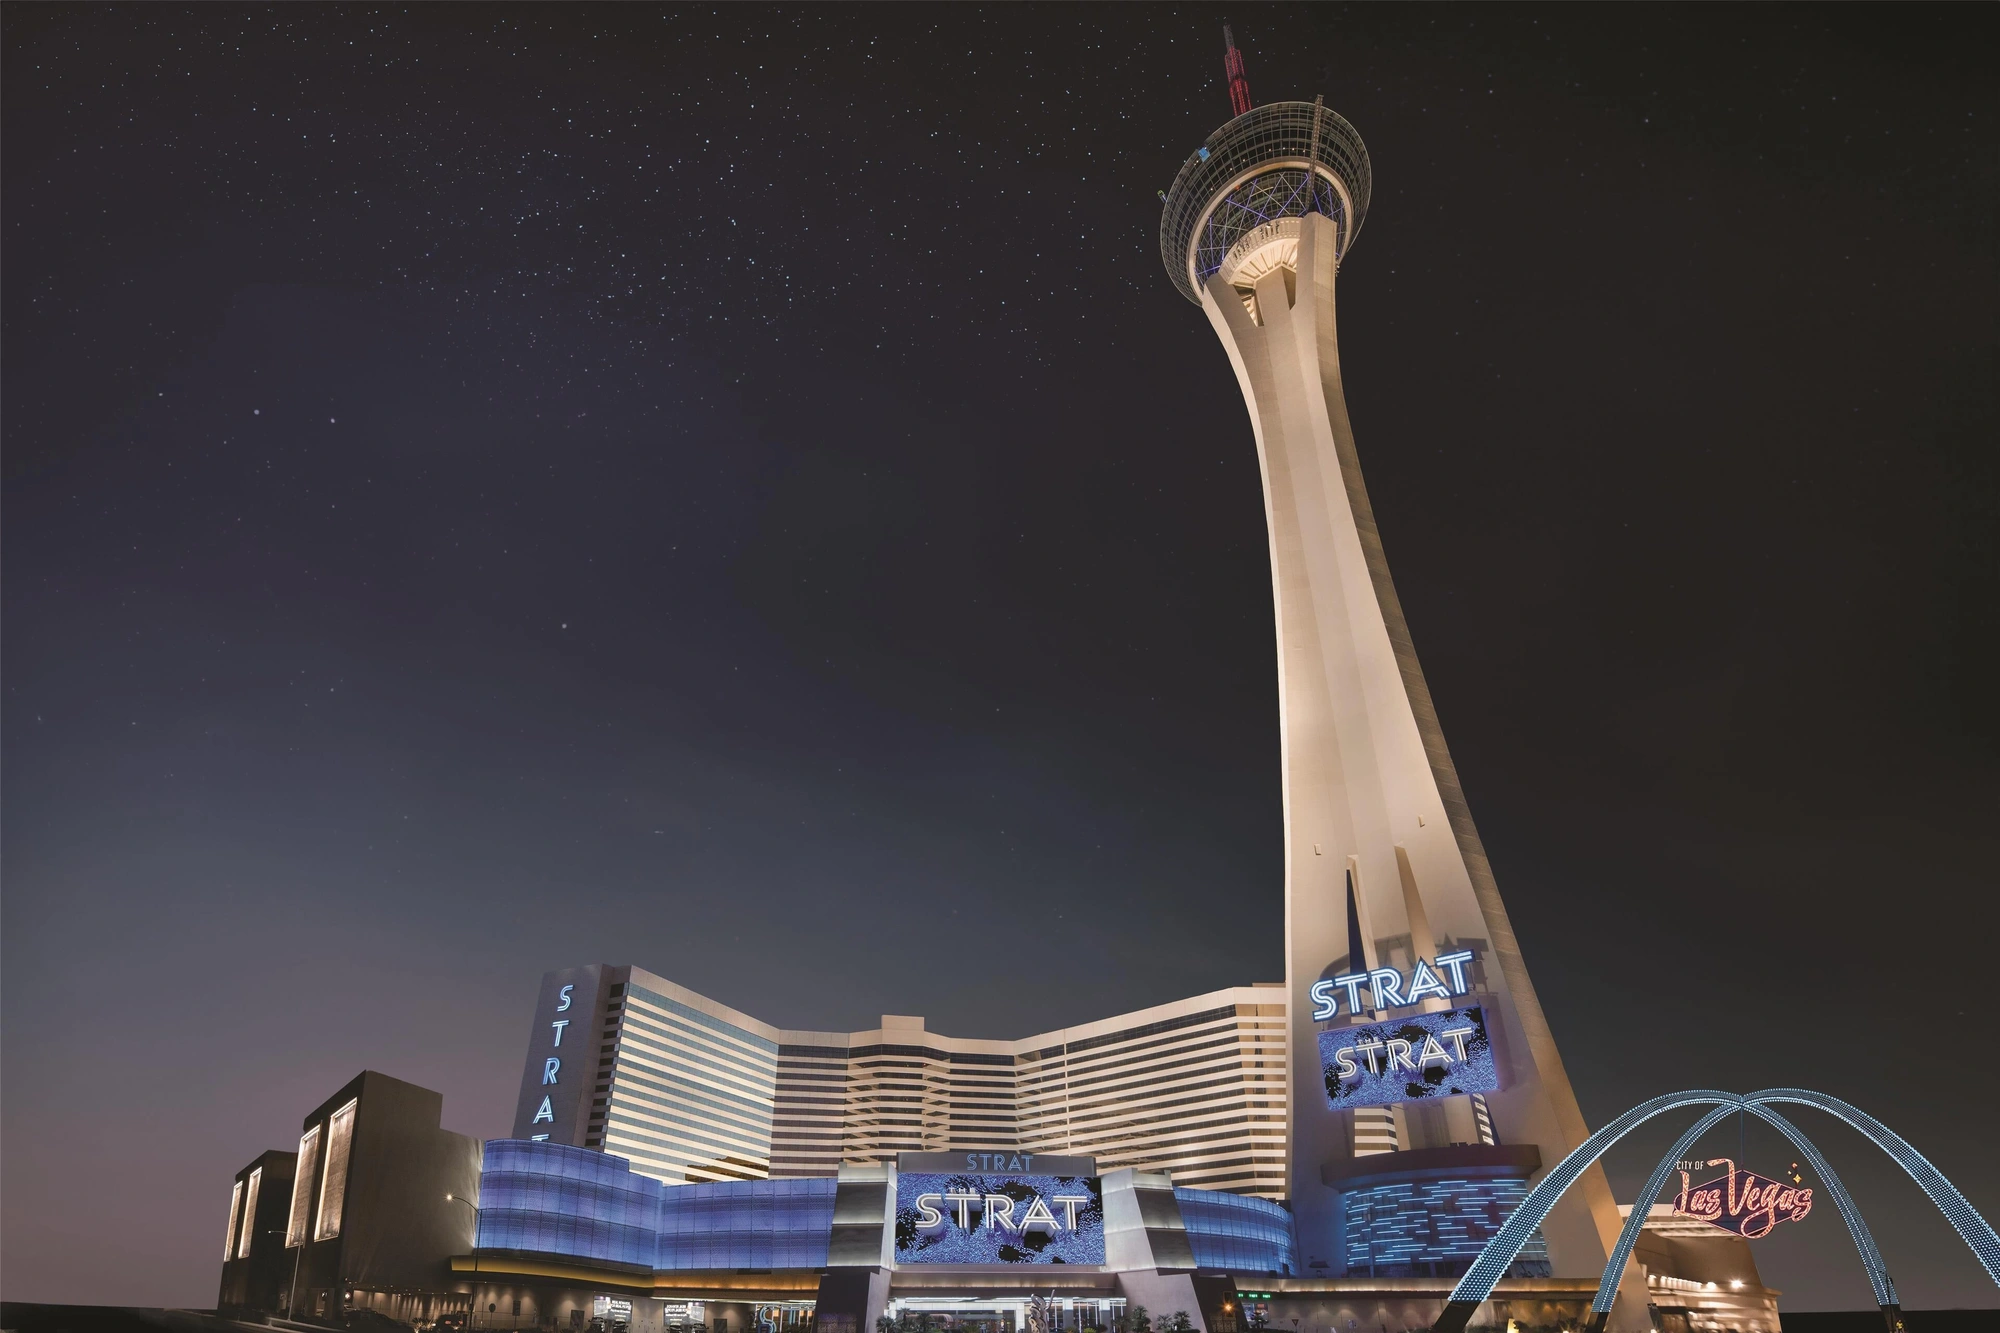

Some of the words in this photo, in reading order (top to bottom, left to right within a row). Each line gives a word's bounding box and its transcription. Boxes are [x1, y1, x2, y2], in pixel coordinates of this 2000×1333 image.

[1310, 949, 1475, 1022] STRAT
[1334, 1027, 1473, 1080] STRAT
[966, 1153, 1034, 1172] STRAT
[1676, 1161, 1693, 1170] CITY
[1694, 1160, 1704, 1170] OF
[915, 1193, 1088, 1231] STRAT
[1673, 1171, 1722, 1220] Las
[1707, 1158, 1813, 1239] Vegas
